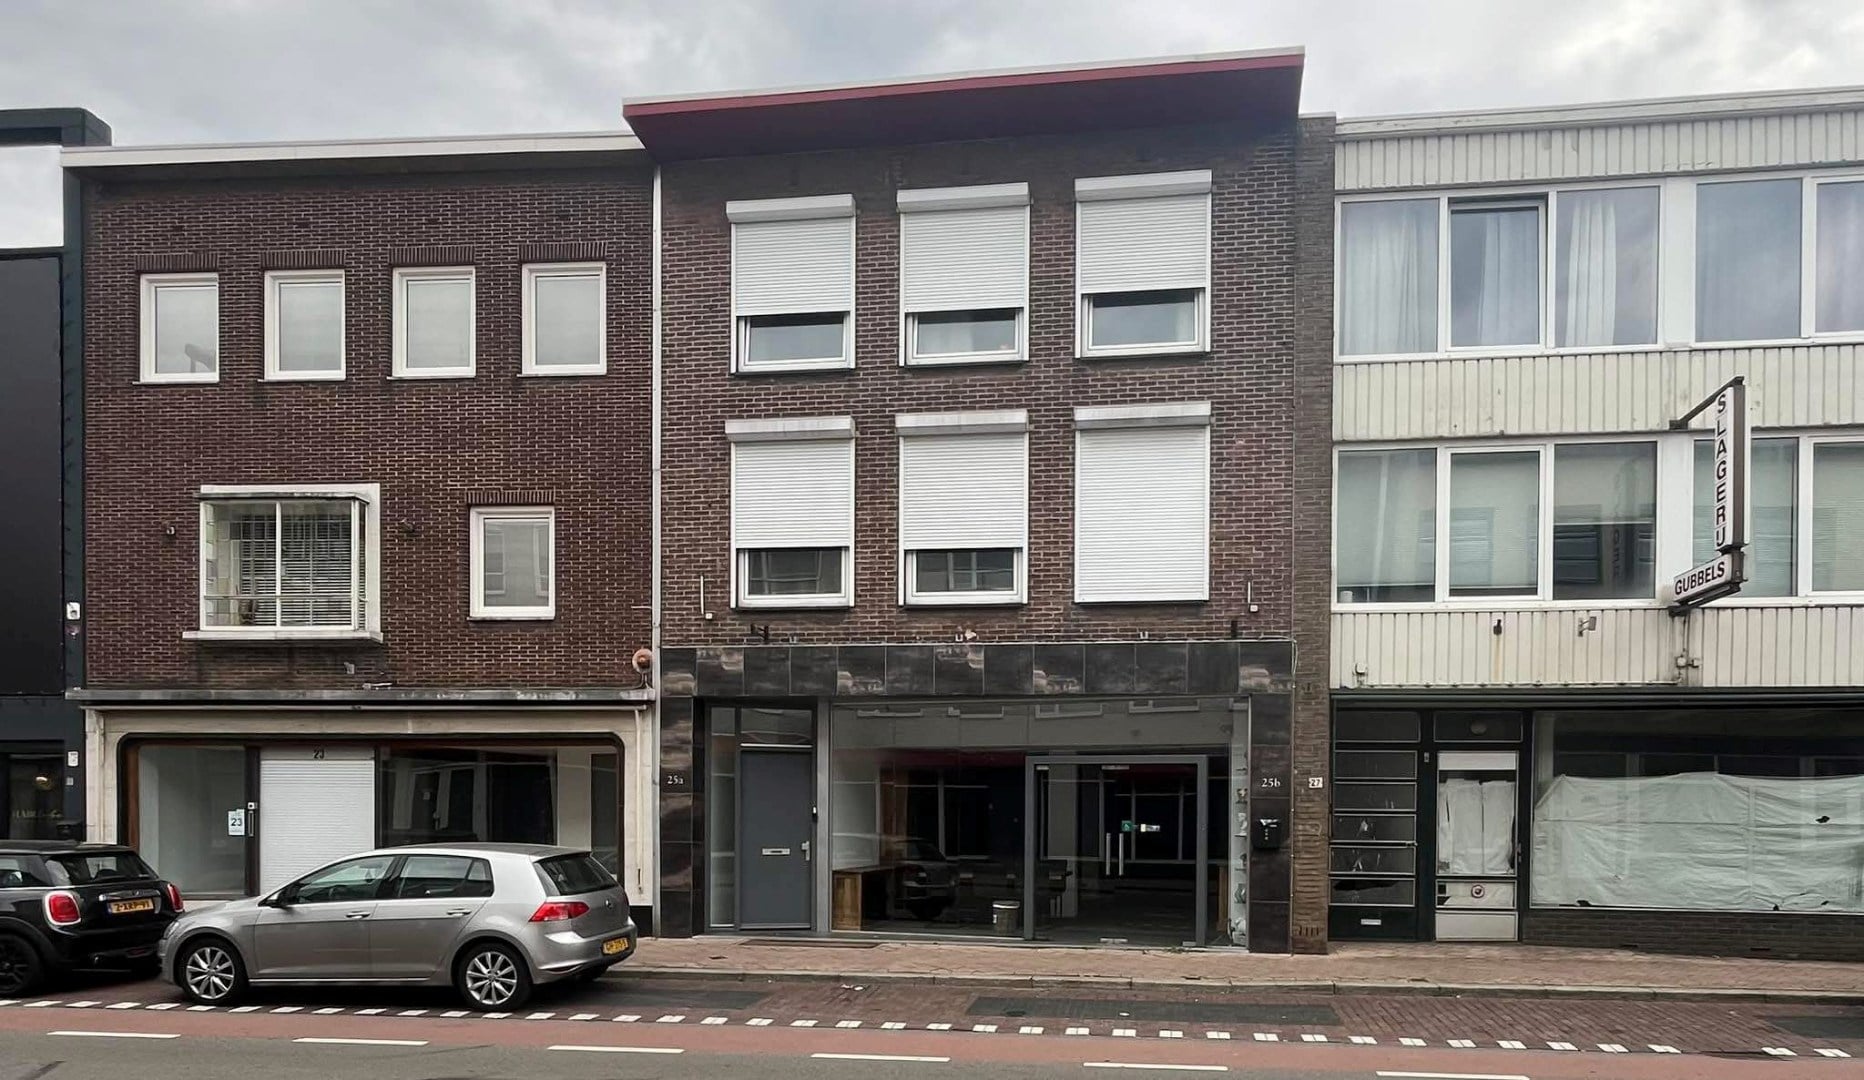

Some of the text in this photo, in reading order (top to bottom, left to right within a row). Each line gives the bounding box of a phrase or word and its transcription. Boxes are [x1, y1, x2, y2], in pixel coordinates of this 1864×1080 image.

[1674, 561, 1725, 596] GUBBELS
[313, 749, 325, 759] 23
[667, 775, 684, 785] 25a
[1261, 777, 1281, 788] 25b
[1310, 778, 1321, 787] 27
[230, 817, 243, 827] 23
